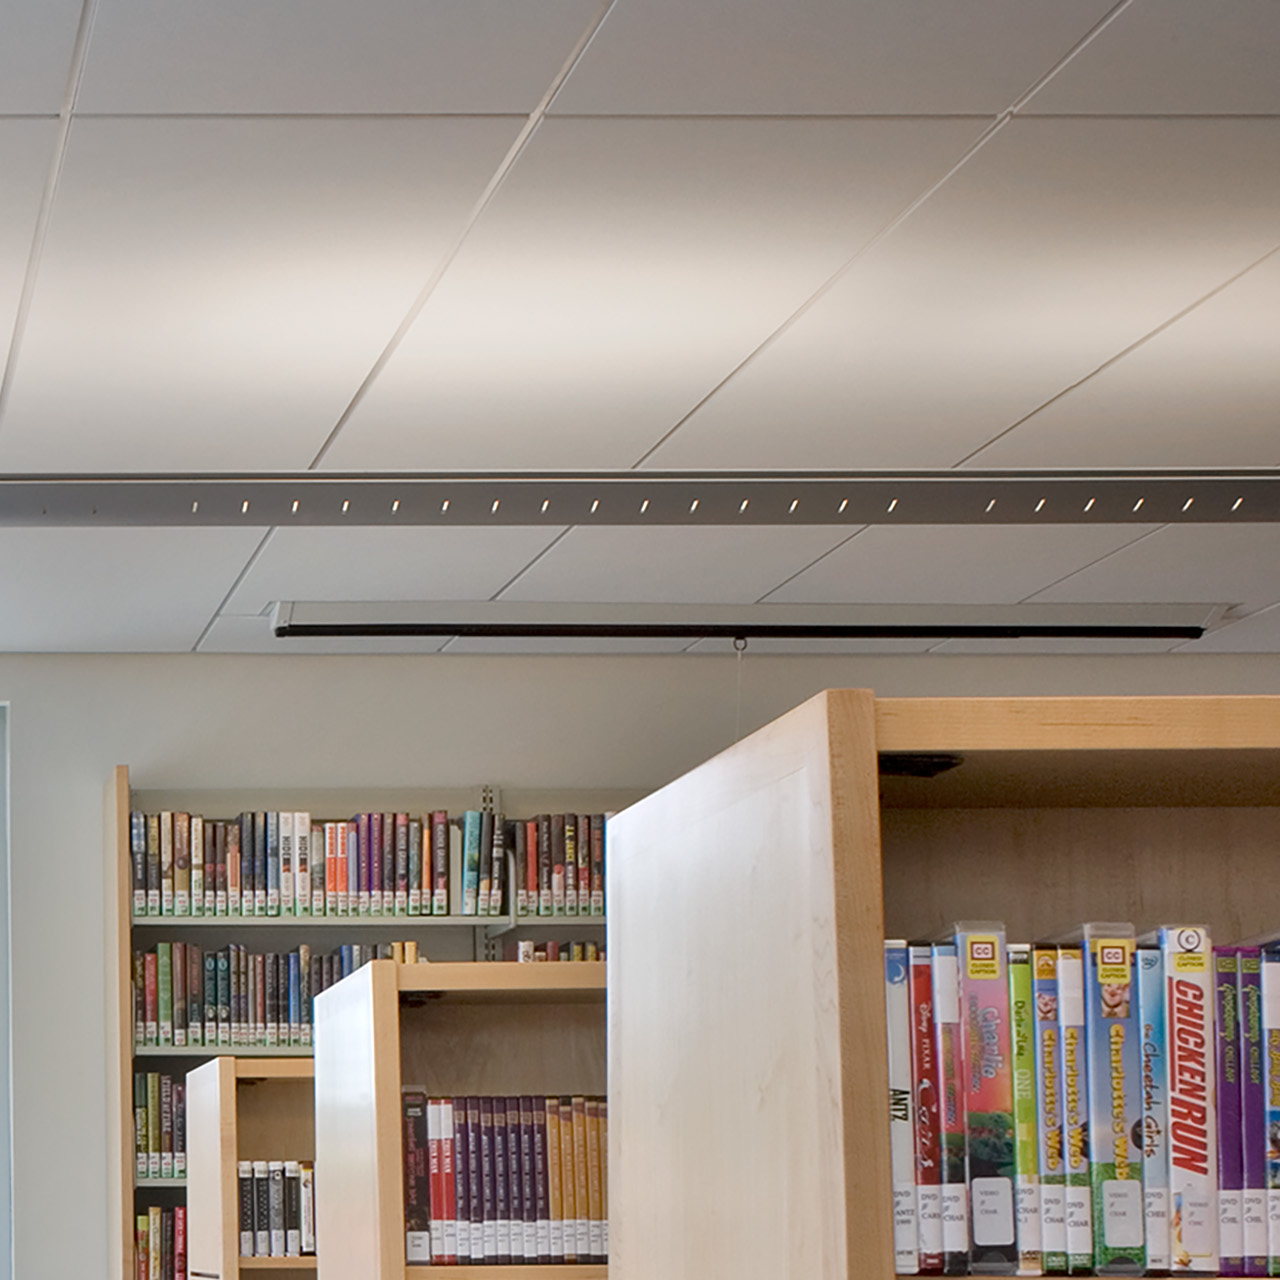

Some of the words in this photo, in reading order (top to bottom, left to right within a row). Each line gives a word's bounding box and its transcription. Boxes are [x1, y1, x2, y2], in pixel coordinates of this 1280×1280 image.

[921, 1038, 930, 1070] PIXAR
[979, 1007, 1004, 1078] Charlie
[1176, 980, 1207, 1102] CHICKEN
[1017, 1069, 1031, 1100] ONE
[1043, 1029, 1058, 1127] Charlotte's
[1065, 1027, 1080, 1126] Charlotte's
[1109, 1023, 1127, 1134] Charlotte's
[1143, 1042, 1161, 1111] Cheetah
[889, 1089, 910, 1122] ANTZ
[1046, 1128, 1061, 1170] Web
[1067, 1126, 1083, 1169] Web
[1113, 1135, 1130, 1180] Web
[1143, 1115, 1162, 1158] Girls
[1171, 1096, 1208, 1176] RUN
